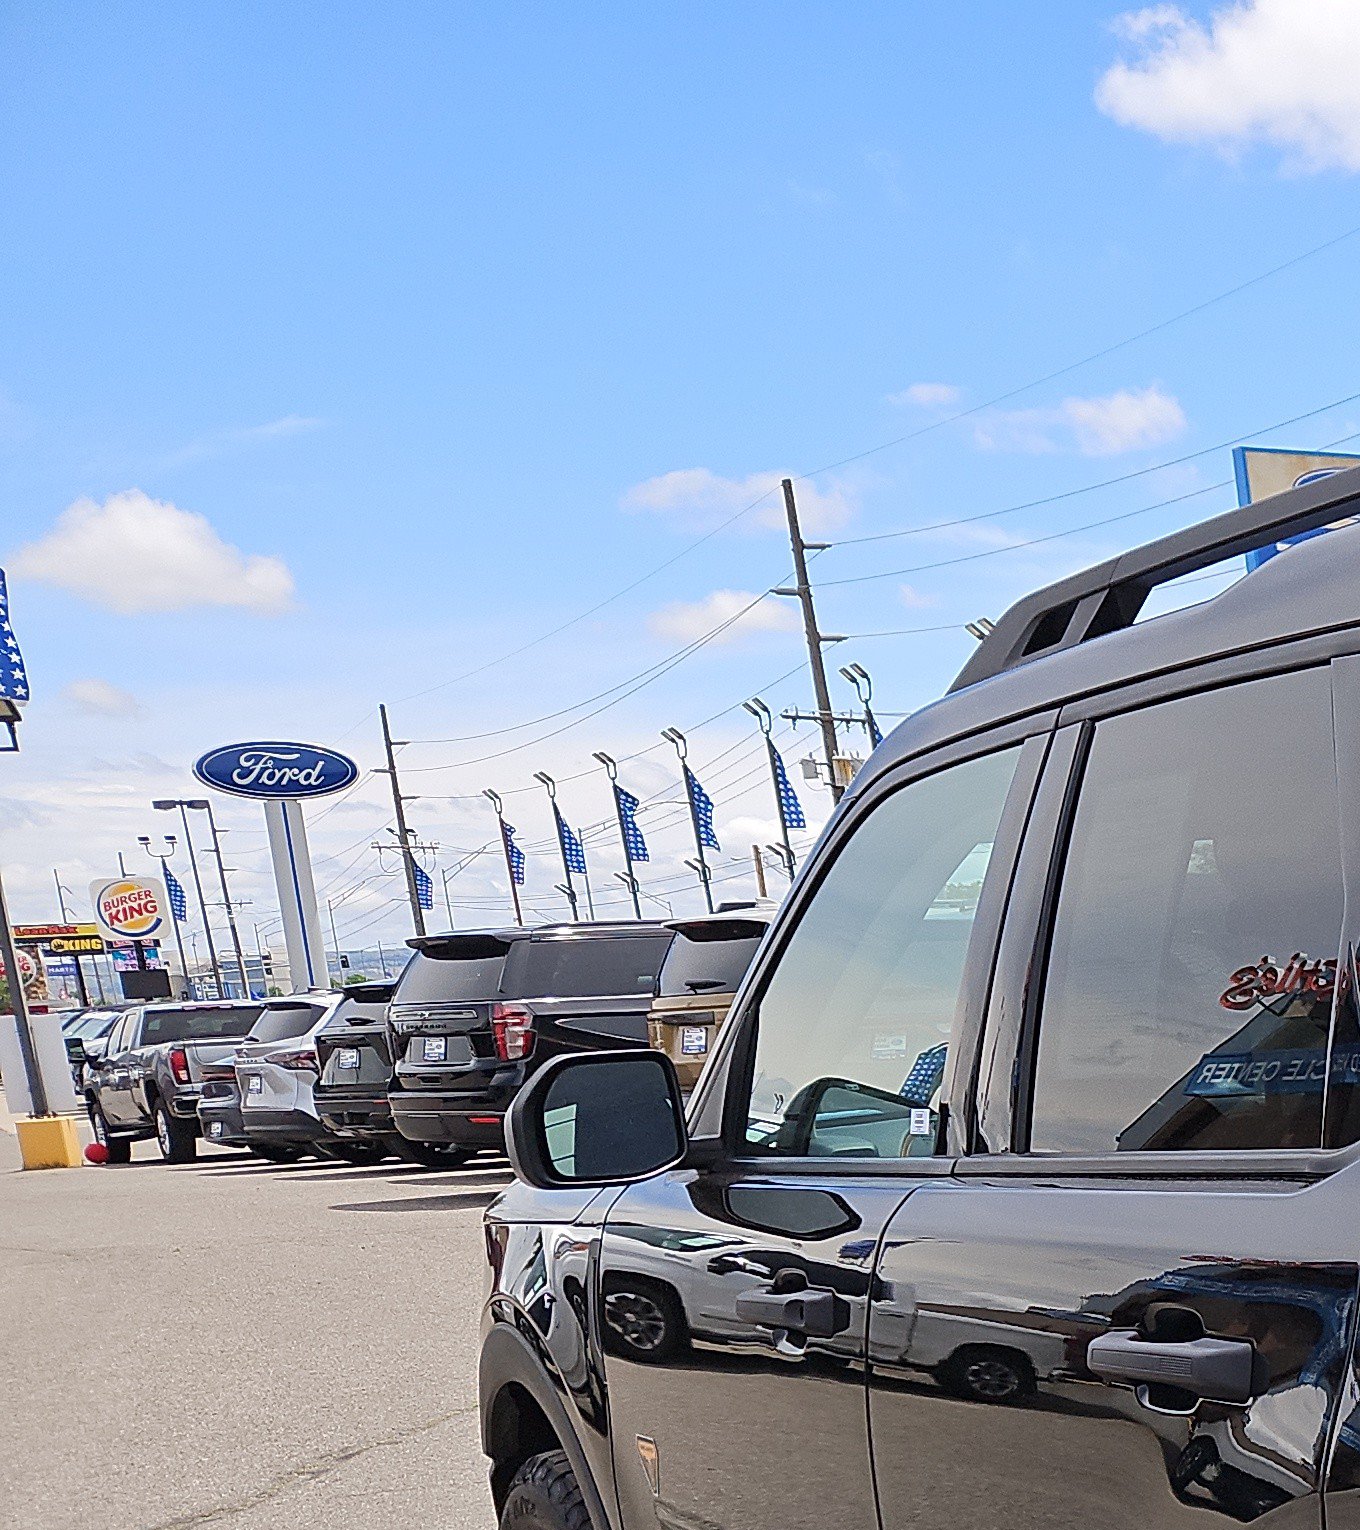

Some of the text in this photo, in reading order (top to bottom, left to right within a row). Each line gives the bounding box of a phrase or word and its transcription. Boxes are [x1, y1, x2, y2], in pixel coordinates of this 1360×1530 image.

[232, 751, 325, 786] Ford
[103, 889, 153, 912] BURGER
[108, 899, 158, 926] KING
[63, 938, 103, 950] KING
